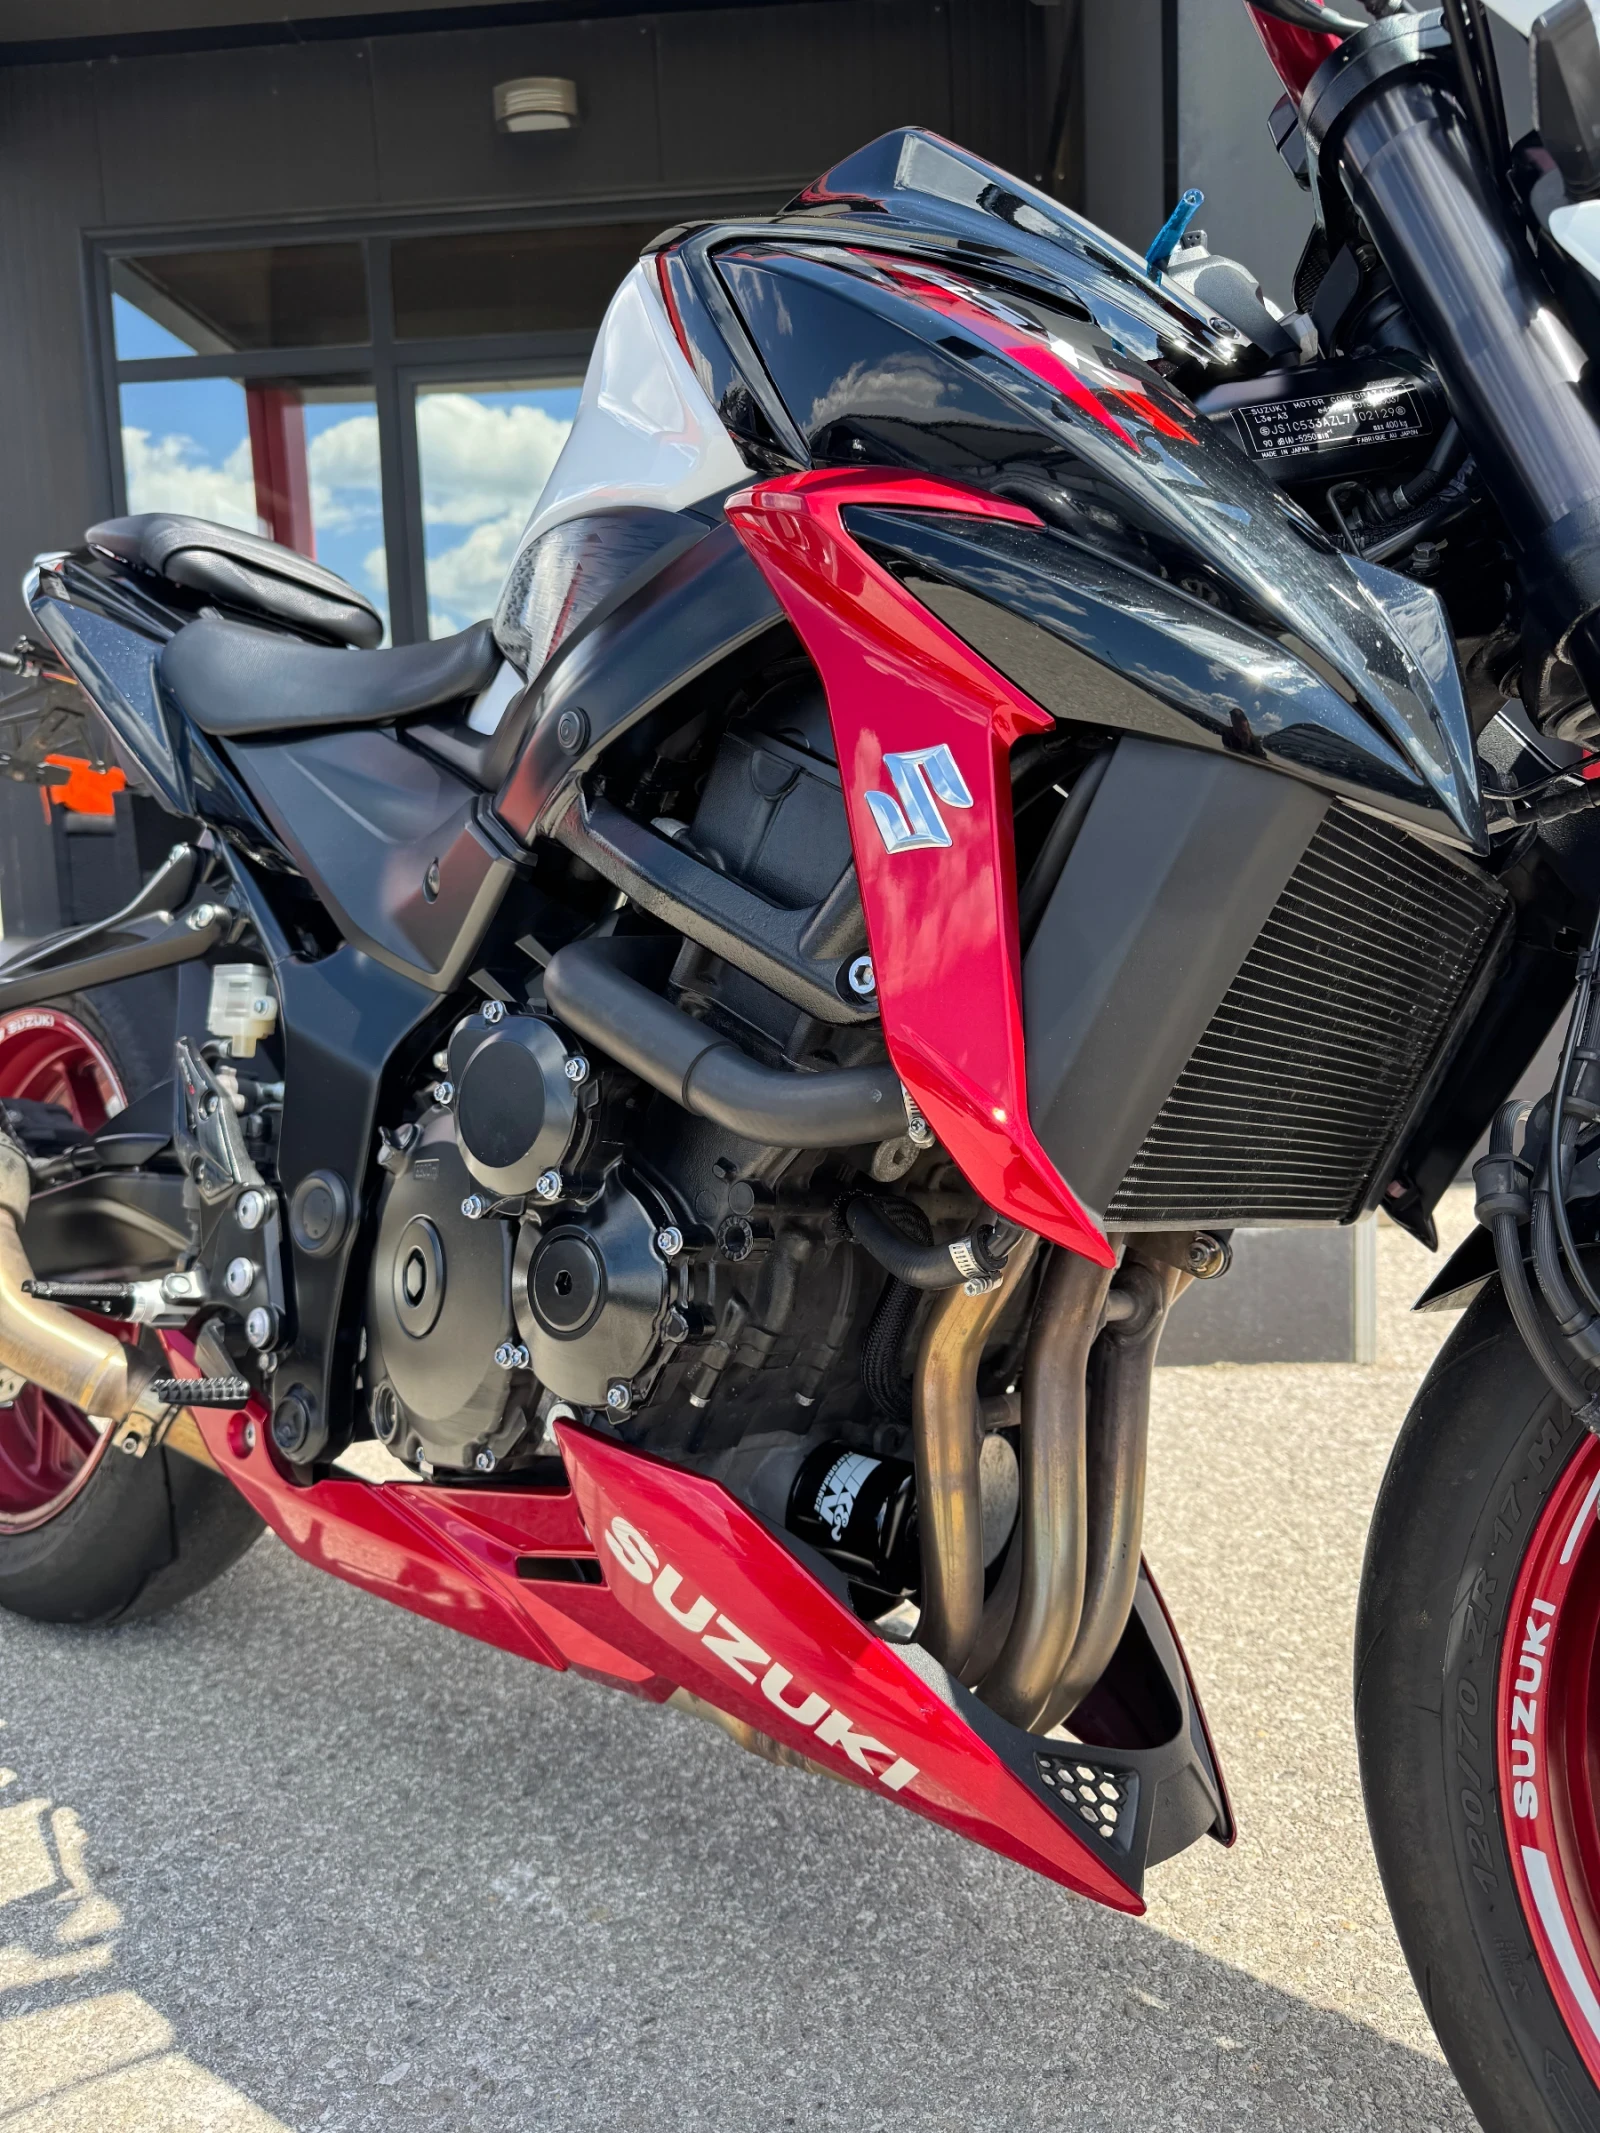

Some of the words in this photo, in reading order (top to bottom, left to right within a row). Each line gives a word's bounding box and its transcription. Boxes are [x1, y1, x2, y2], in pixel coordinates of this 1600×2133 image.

[1251, 405, 1286, 415] SUZUKI
[1293, 398, 1325, 409] MOTOR
[1330, 389, 1397, 403] CORPORATION
[1271, 407, 1395, 435] JS1C533AZL7102129
[1261, 450, 1277, 458] MADE
[1281, 448, 1289, 456] IN
[1291, 446, 1310, 454] JAPAN
[1356, 433, 1386, 444] FABRIQUE
[1400, 429, 1419, 438] JAPON
[1262, 440, 1272, 448] 90
[1386, 421, 1398, 430] 400
[1399, 420, 1408, 429] kg
[8, 1014, 55, 1034] SUZUKI
[814, 1450, 854, 1513] PERFORMANCE
[1493, 1484, 1523, 1544] 17
[1464, 1567, 1498, 1658] ZR
[604, 1516, 920, 1792] SUZUKI
[1513, 1597, 1557, 1820] SUZUKI
[1456, 1677, 1499, 1894] 120/70
